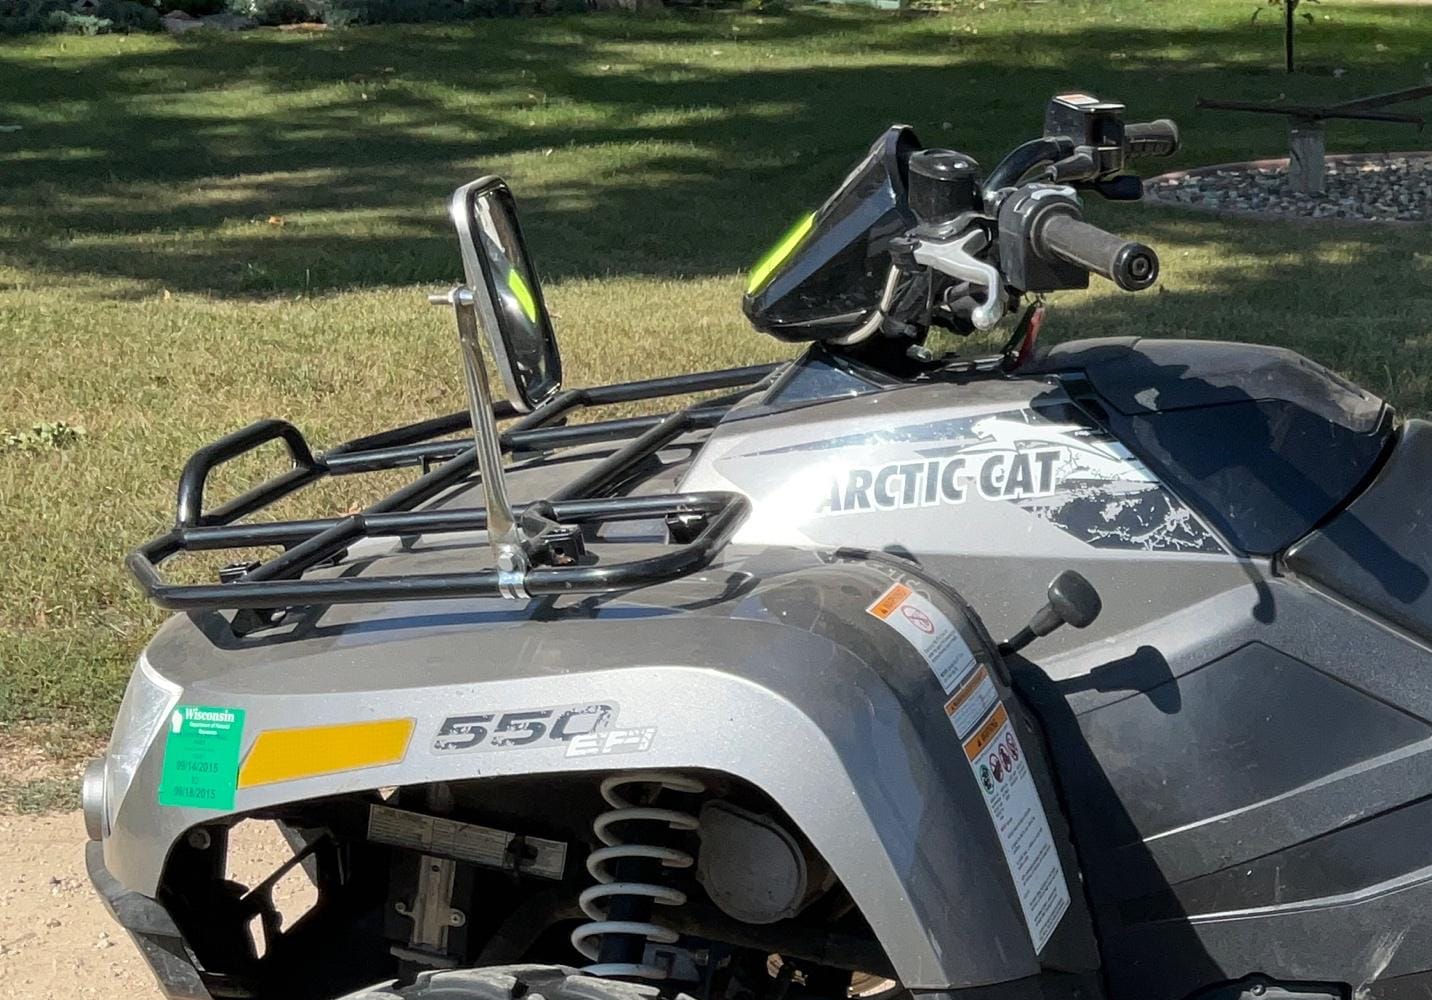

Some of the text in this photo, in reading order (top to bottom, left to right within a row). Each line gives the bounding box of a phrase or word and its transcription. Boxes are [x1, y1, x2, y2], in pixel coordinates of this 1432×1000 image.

[815, 450, 1062, 513] ARCTIC CAT
[185, 708, 235, 723] Wisconsin
[433, 703, 612, 750] 550
